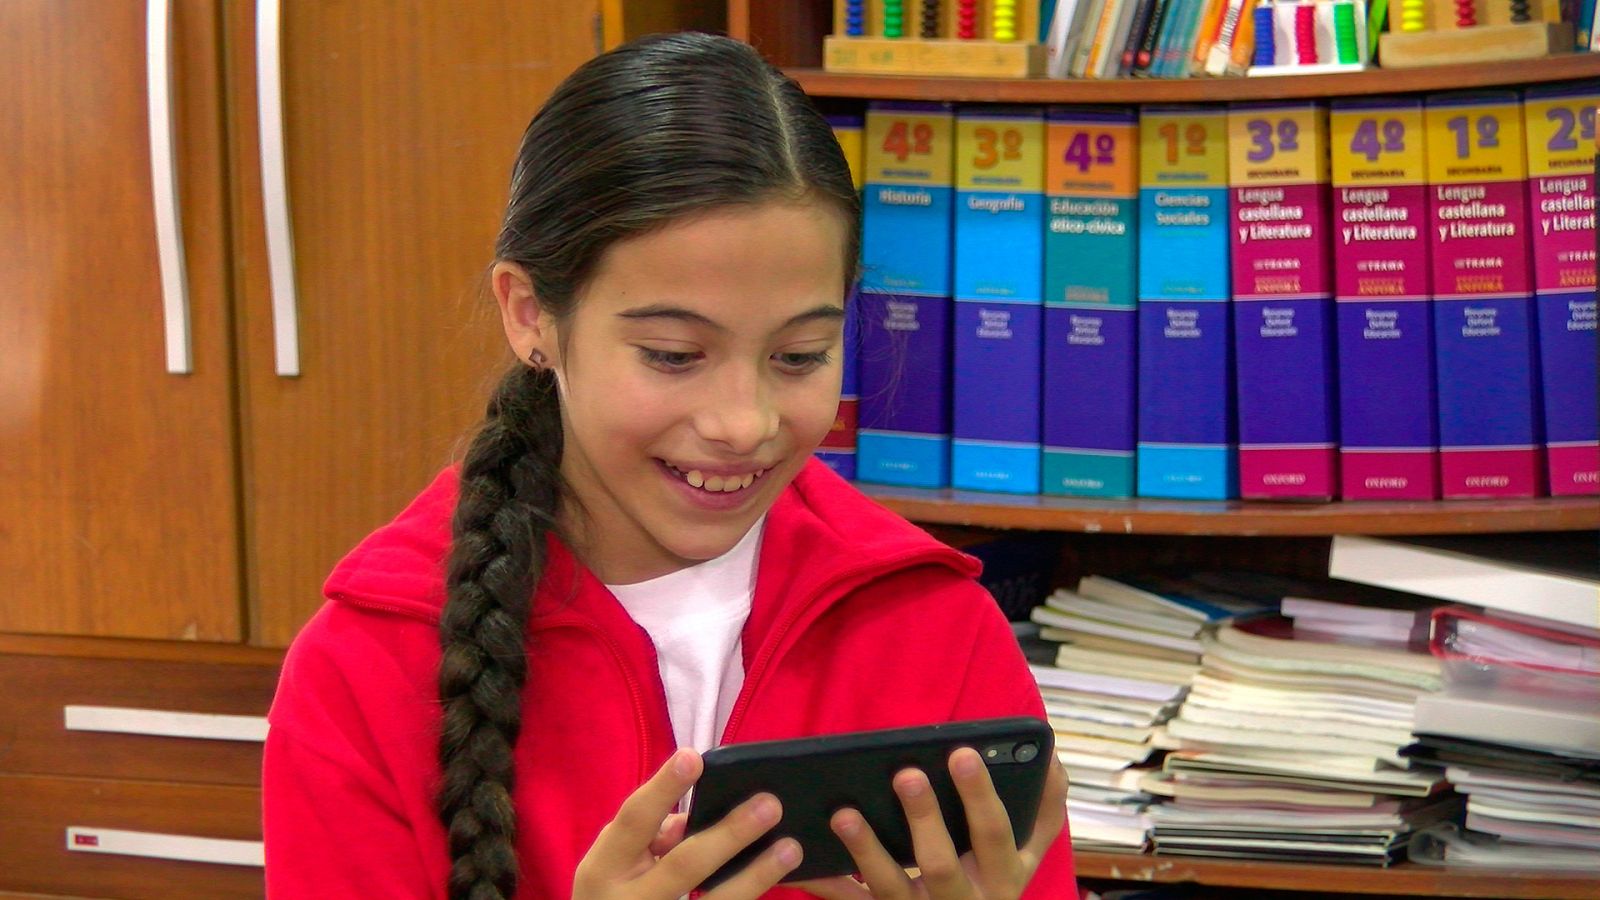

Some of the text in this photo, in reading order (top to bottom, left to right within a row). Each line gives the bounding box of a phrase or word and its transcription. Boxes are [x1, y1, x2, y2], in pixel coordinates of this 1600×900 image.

[882, 120, 934, 163] 4º
[1159, 122, 1207, 166] 1º
[1246, 119, 1299, 163] 3º
[1350, 119, 1405, 163] 4º
[1446, 115, 1500, 160] 1º
[973, 127, 1024, 170] 3º
[1064, 132, 1115, 173] 4º
[1238, 188, 1284, 205] Lengua
[1342, 188, 1389, 206] Lengua
[1437, 186, 1486, 204] Lengua
[1540, 178, 1587, 196] Lengua
[1155, 192, 1210, 208] Ciencias
[1439, 201, 1505, 220] castellana
[1238, 204, 1303, 222] castellana
[1342, 205, 1408, 222] castellana
[1239, 223, 1312, 244] y Literatura
[1342, 224, 1417, 245] y Literatura
[1439, 221, 1515, 243] y Literatura
[1542, 219, 1550, 236] y
